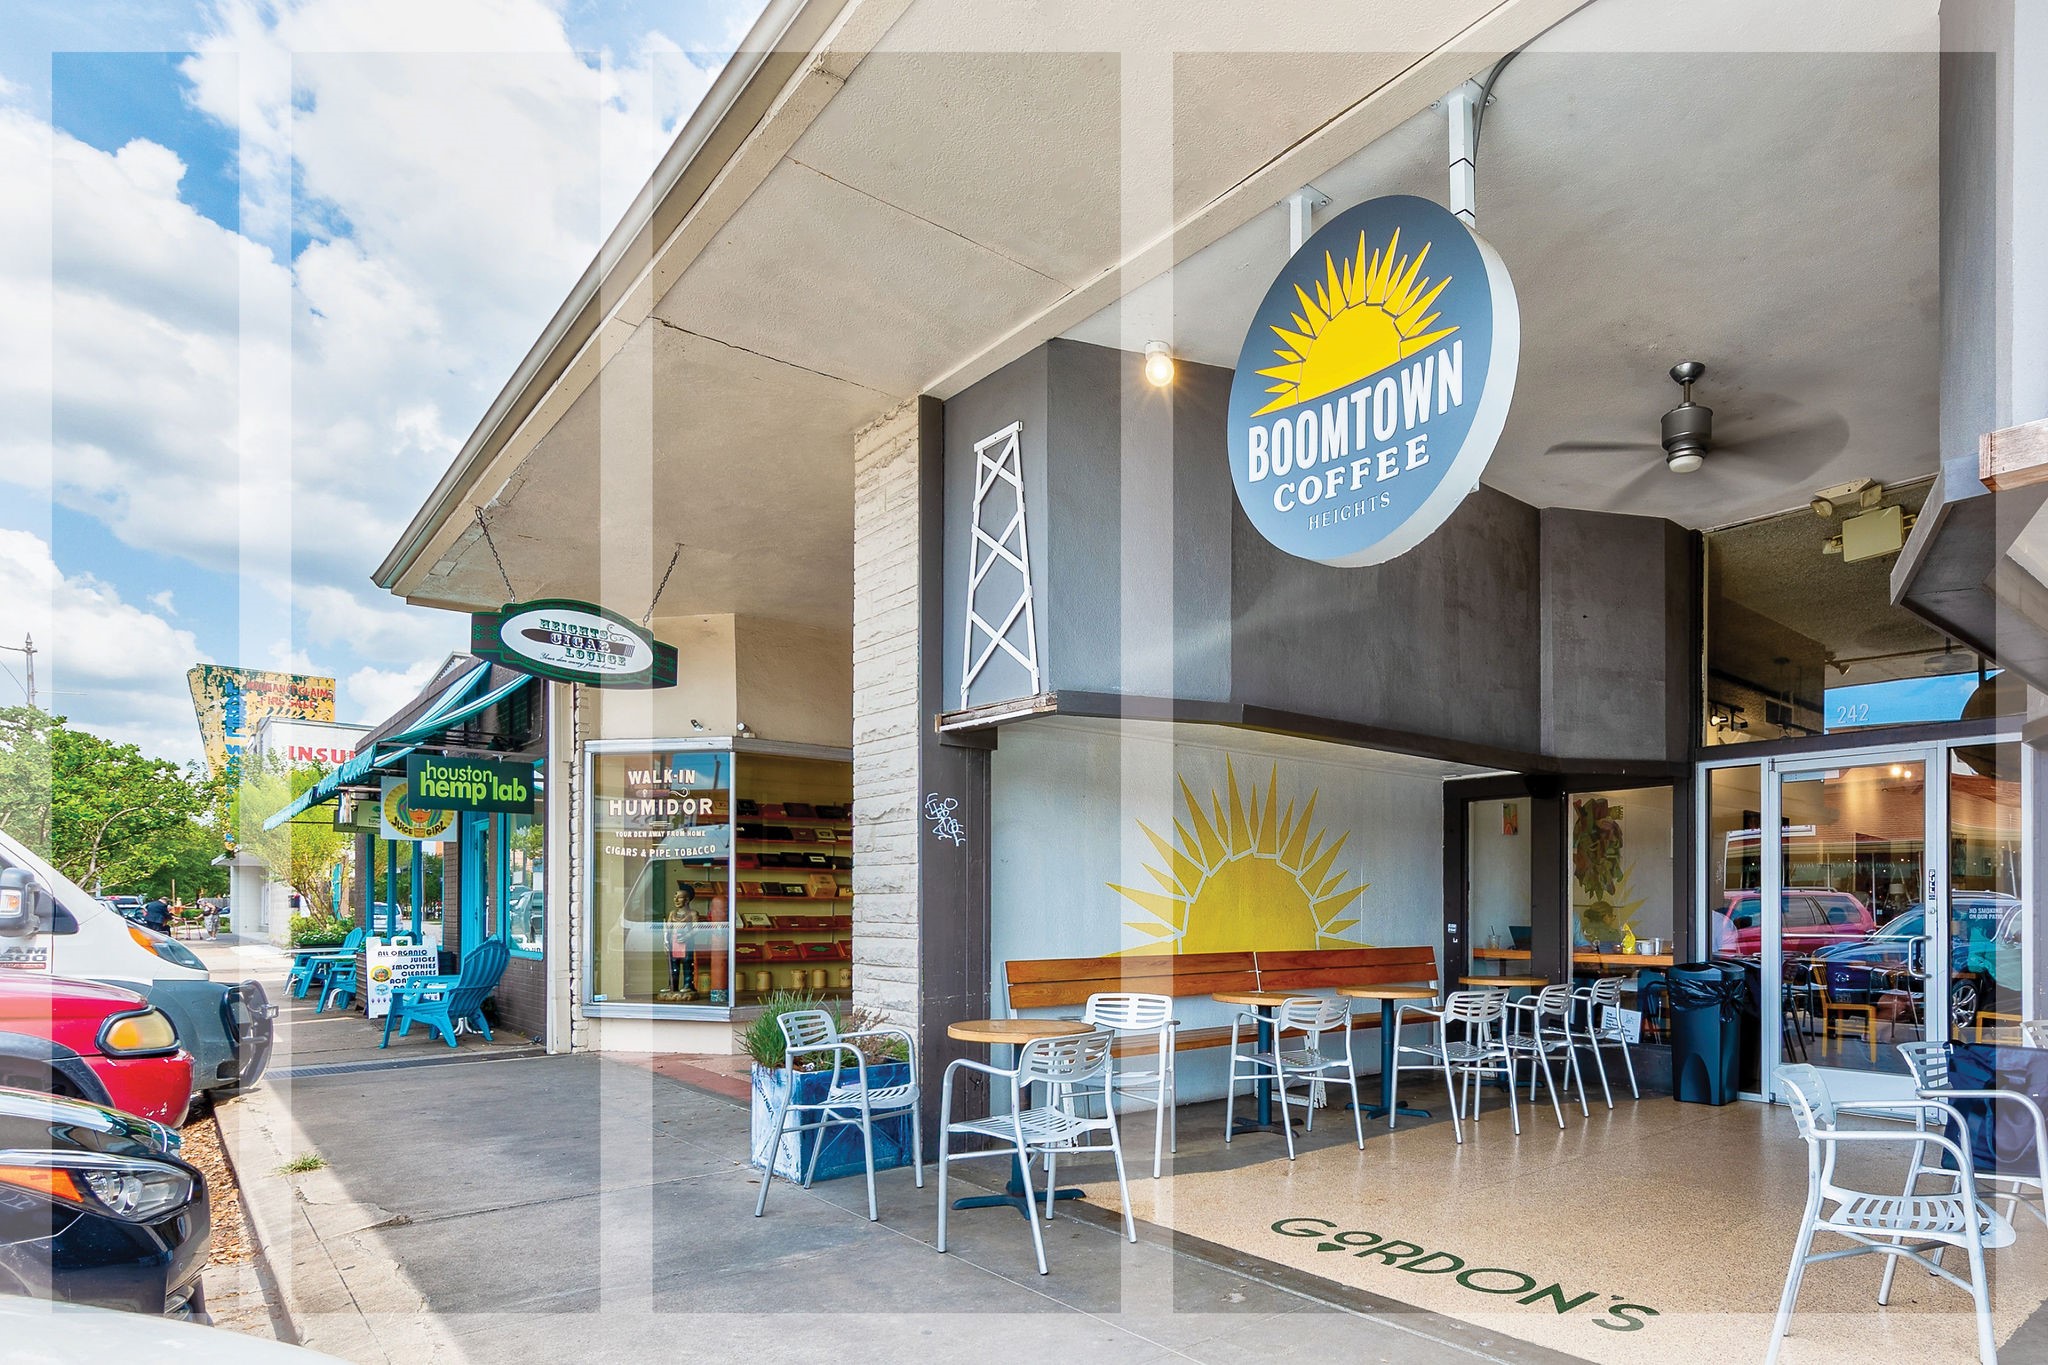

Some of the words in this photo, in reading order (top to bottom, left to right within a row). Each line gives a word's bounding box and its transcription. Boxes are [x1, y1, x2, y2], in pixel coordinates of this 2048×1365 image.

[1248, 339, 1463, 483] BOOMTOWN
[1273, 433, 1431, 512] COFFEE
[1308, 491, 1391, 531] HEIGHTS
[540, 619, 608, 640] HEIGHTS
[550, 632, 611, 653] CIGAR
[540, 652, 555, 661] Your
[568, 659, 584, 668] away
[565, 647, 626, 666] LOUNGE
[1837, 703, 1869, 724] 242
[426, 760, 492, 782] houston
[627, 769, 696, 785] WALK-IN
[420, 771, 487, 805] hemp
[493, 776, 527, 802] lab
[609, 798, 713, 816] HUMIDOR
[391, 816, 413, 835] JUICE
[426, 820, 447, 836] GIRL
[605, 845, 638, 857] CIGARS
[640, 848, 647, 858] &
[649, 849, 671, 858] PIPE
[674, 845, 716, 857] TOBACCO
[377, 949, 389, 957] ALL
[390, 949, 428, 957] ORGANIC
[391, 963, 436, 971] SMOOTHIES
[1270, 1217, 1660, 1332] GORDON'S
